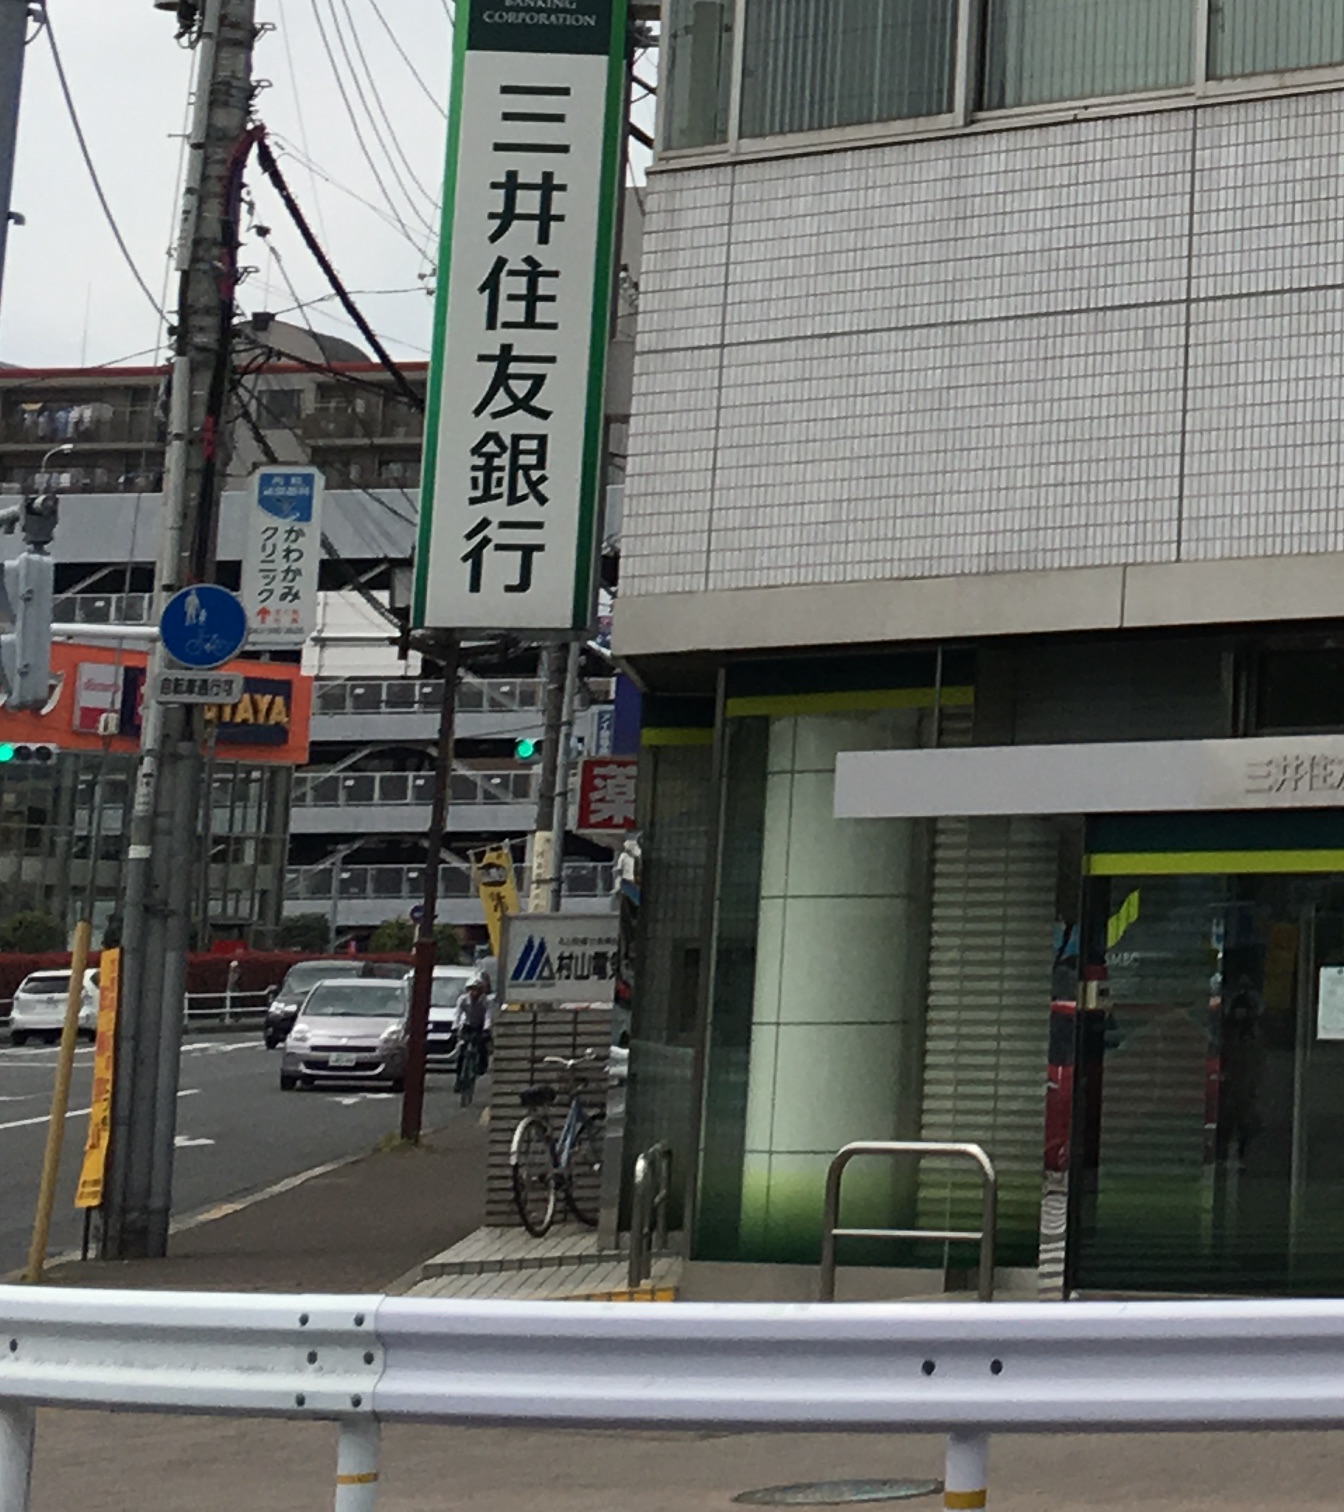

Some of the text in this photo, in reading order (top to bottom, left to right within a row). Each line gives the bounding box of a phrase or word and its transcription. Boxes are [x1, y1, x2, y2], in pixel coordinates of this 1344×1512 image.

[482, 10, 597, 27] CORPORATION
[460, 84, 572, 595] 三井住友銀行
[256, 526, 279, 604] クリニック
[279, 524, 306, 604] かわかみ
[588, 764, 638, 825] 薬
